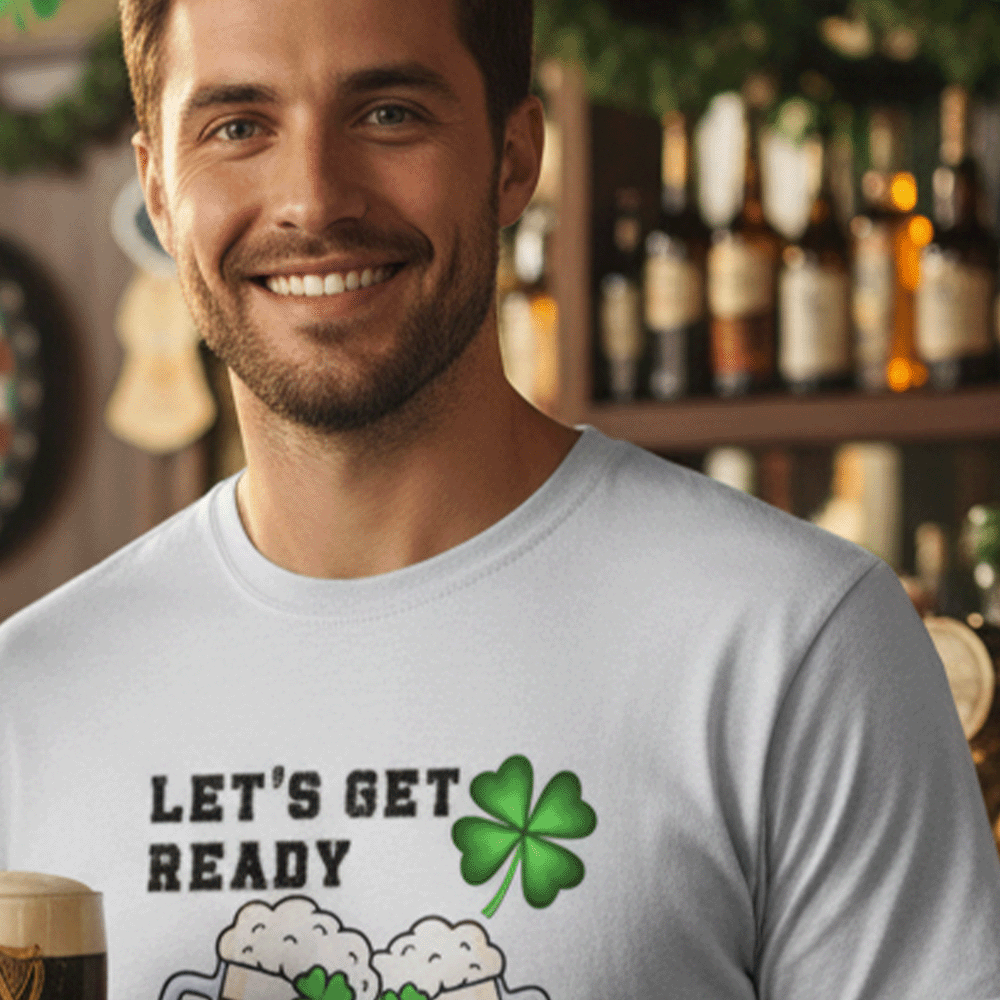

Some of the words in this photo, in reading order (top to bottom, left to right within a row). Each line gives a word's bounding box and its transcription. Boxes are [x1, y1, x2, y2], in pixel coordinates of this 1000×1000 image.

[150, 765, 321, 823] LET'S
[344, 768, 460, 819] GET
[147, 840, 351, 892] READY
